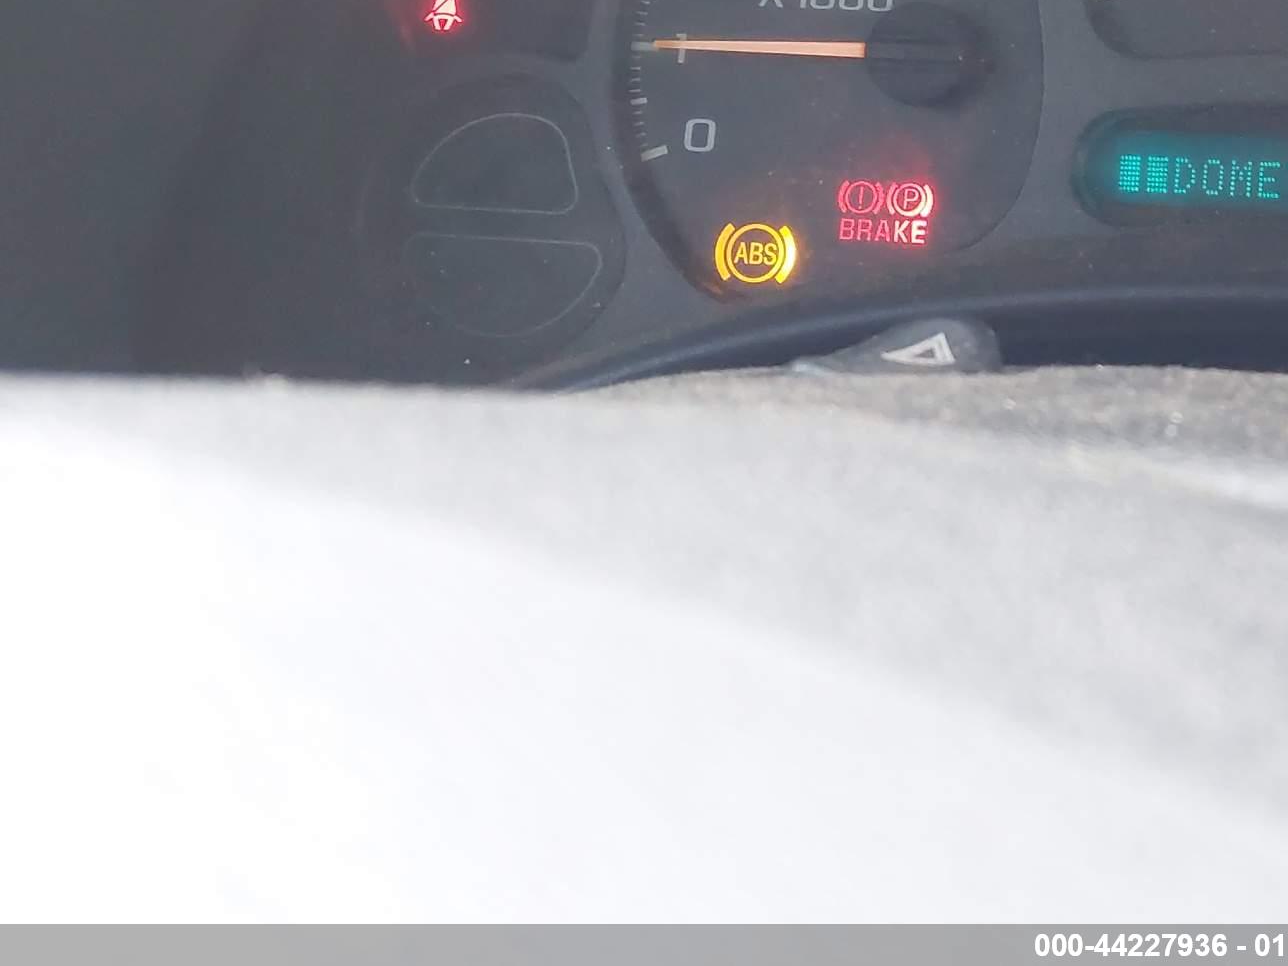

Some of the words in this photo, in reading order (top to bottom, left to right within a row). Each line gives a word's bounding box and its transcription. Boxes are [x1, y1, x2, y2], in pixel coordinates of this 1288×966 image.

[684, 118, 716, 152] 0
[839, 217, 928, 245] BRAKE
[733, 241, 778, 266] ABS
